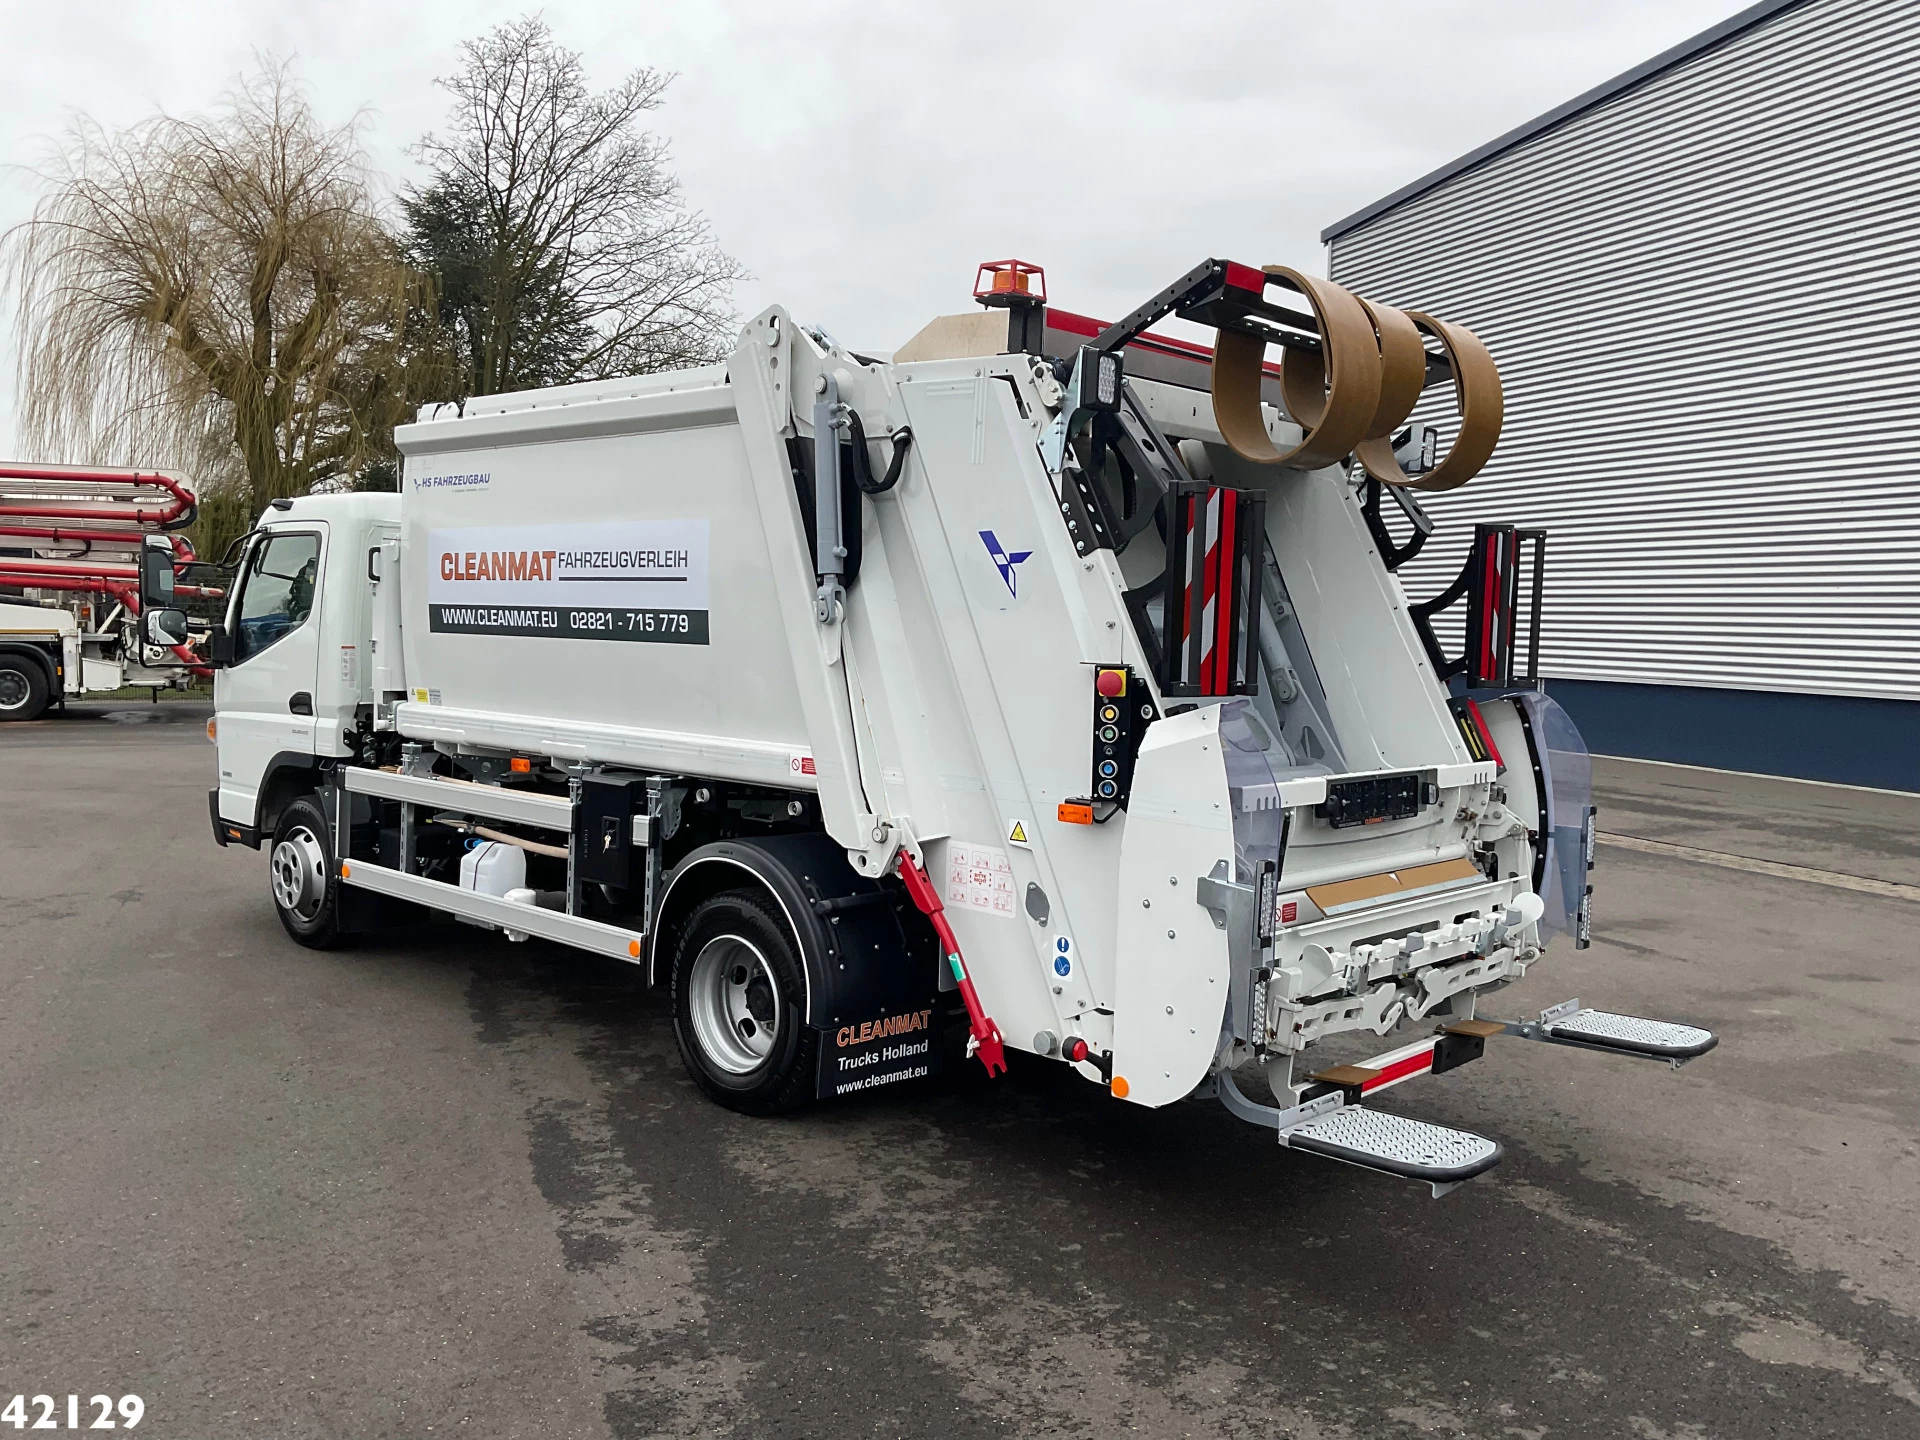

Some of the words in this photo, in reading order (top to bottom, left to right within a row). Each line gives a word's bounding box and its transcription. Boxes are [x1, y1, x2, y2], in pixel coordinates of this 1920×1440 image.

[422, 477, 432, 488] HS
[433, 473, 491, 487] FAHRZEUGBAU
[441, 551, 556, 581] CLEANMAT
[558, 550, 688, 568] FAHRZEUGVERLEIH
[441, 608, 558, 628] WWW.CLEANMAT.EU
[570, 612, 613, 630] 02821
[626, 613, 655, 631] 715
[659, 614, 689, 633] 779
[836, 1009, 931, 1047] CLEANMAT
[837, 1051, 879, 1071] Trucks
[882, 1039, 928, 1061] Holland
[836, 1065, 928, 1095] www.cleanmat.eu
